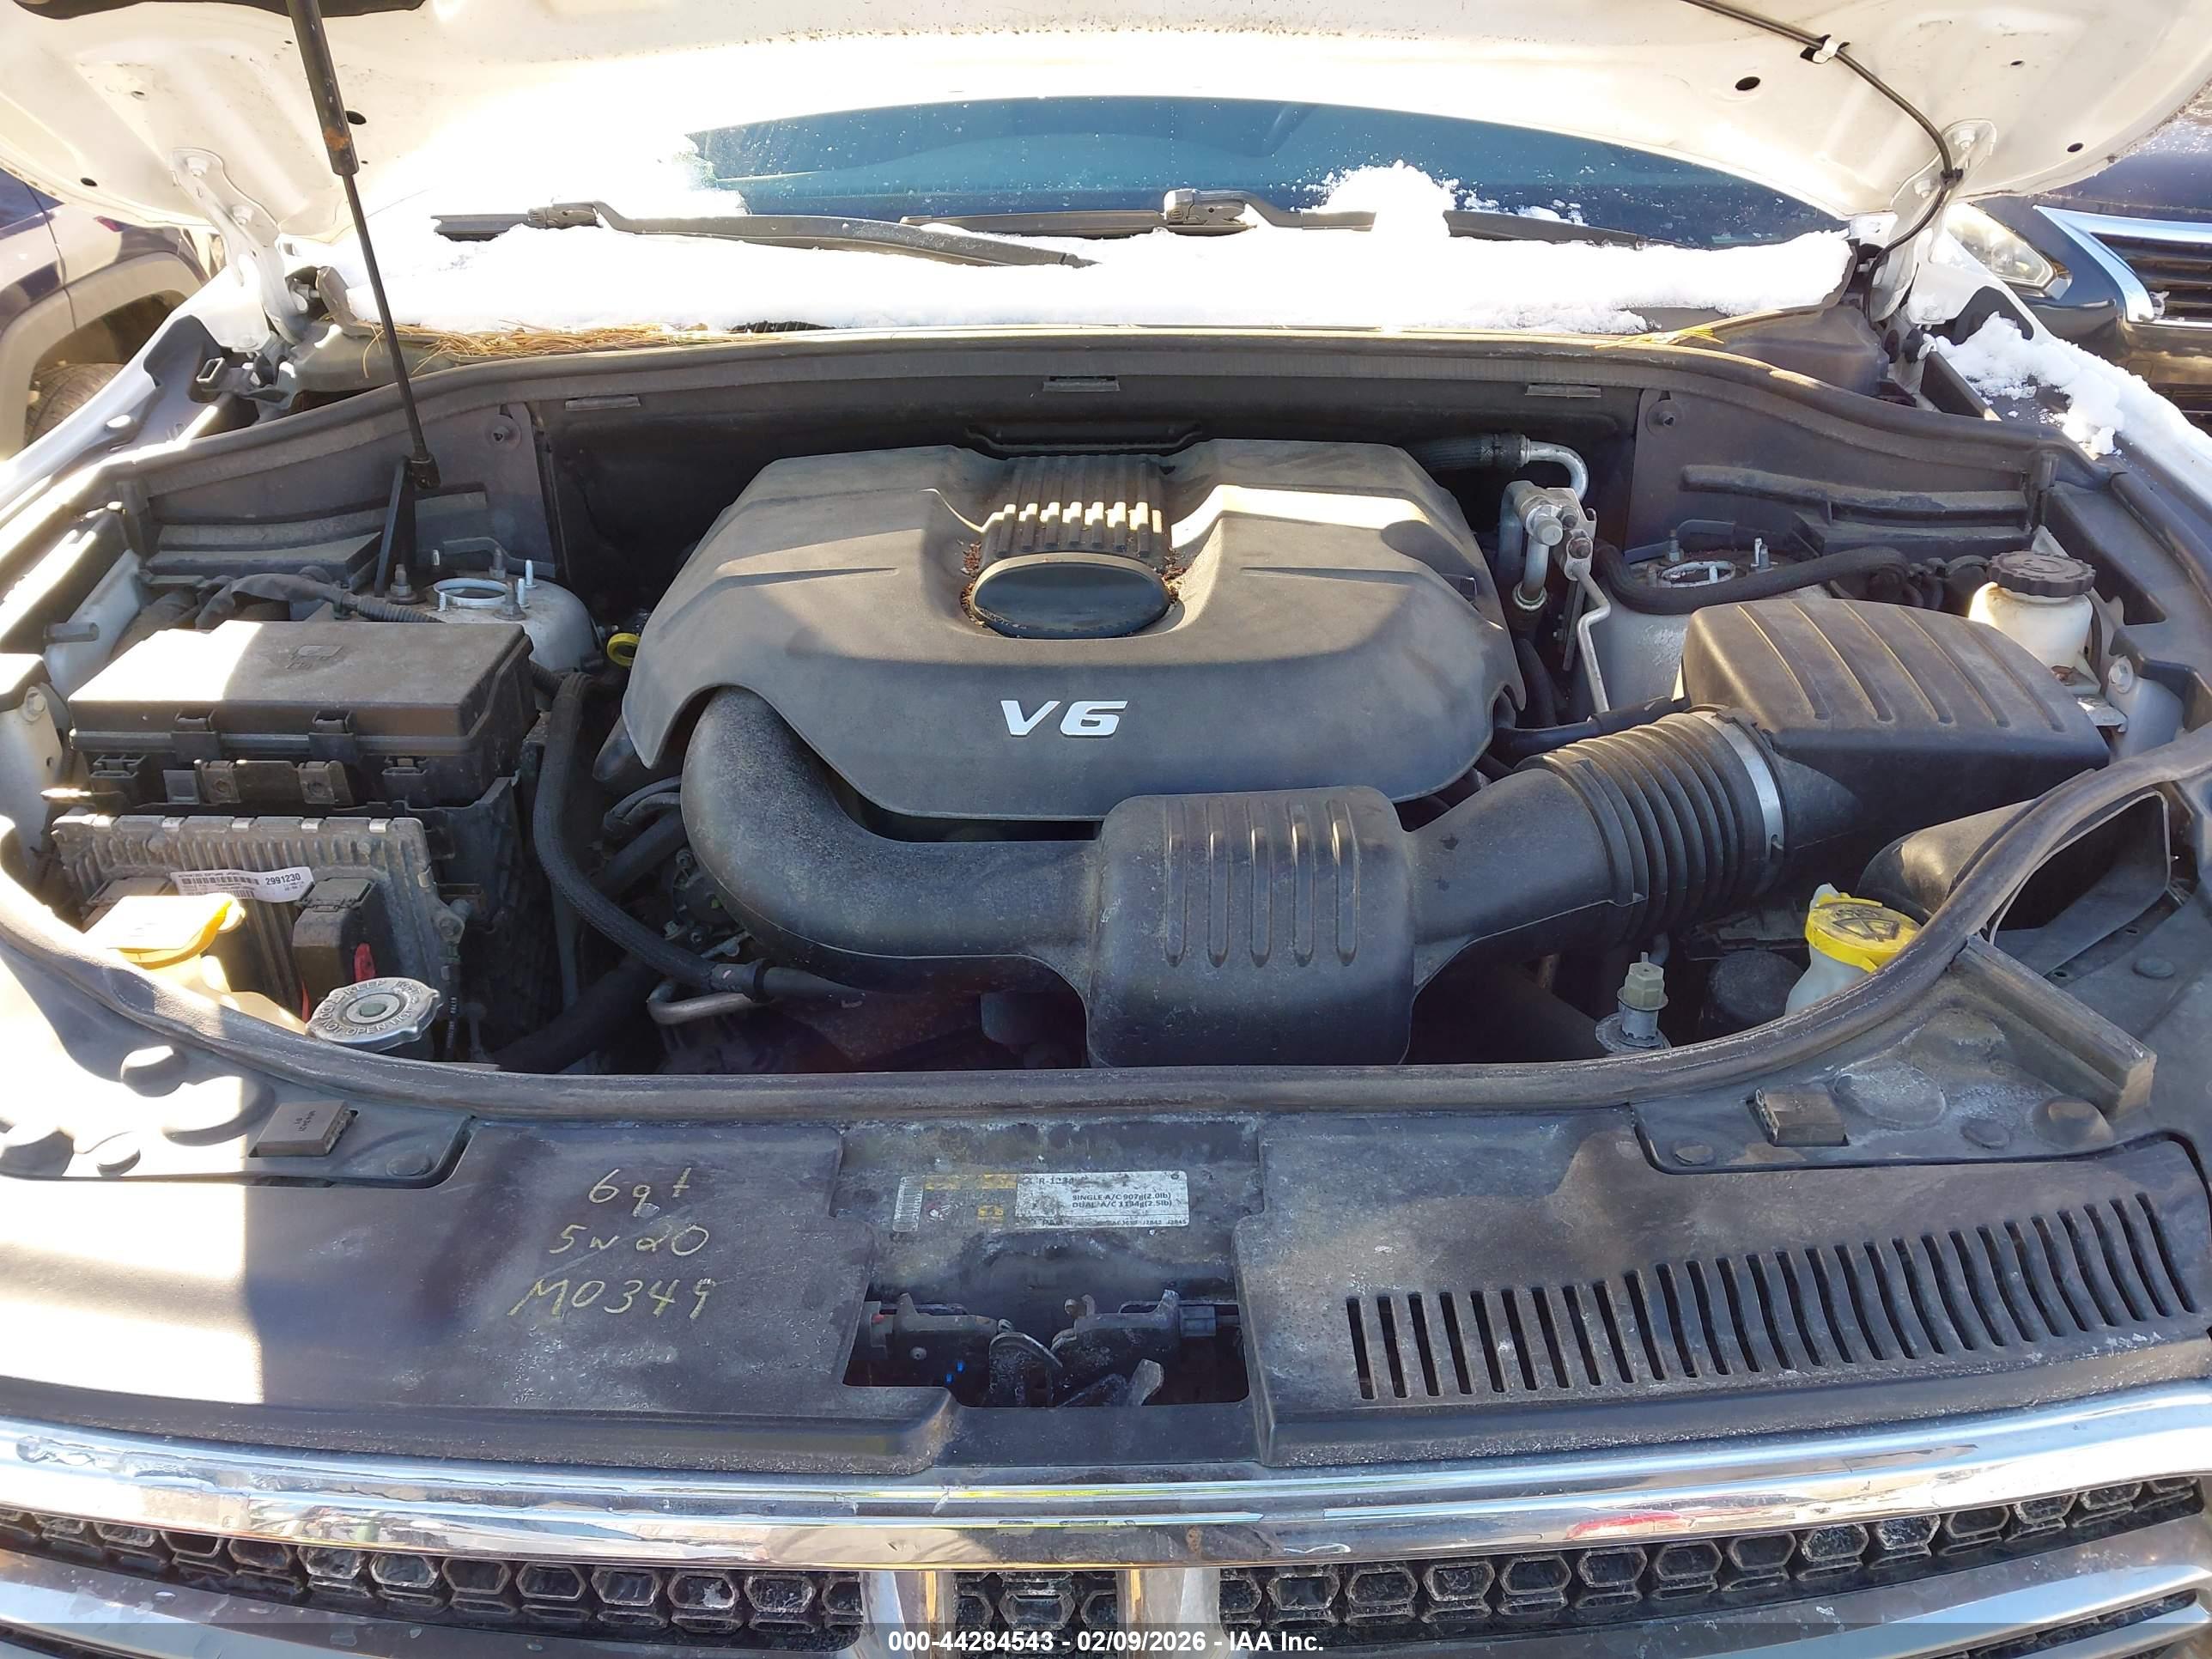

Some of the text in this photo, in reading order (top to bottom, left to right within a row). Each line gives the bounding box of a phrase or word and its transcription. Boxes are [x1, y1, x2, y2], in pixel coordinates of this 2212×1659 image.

[1000, 700, 1128, 736] V6
[264, 872, 301, 885] 2991230
[345, 1022, 386, 1036] OPEN
